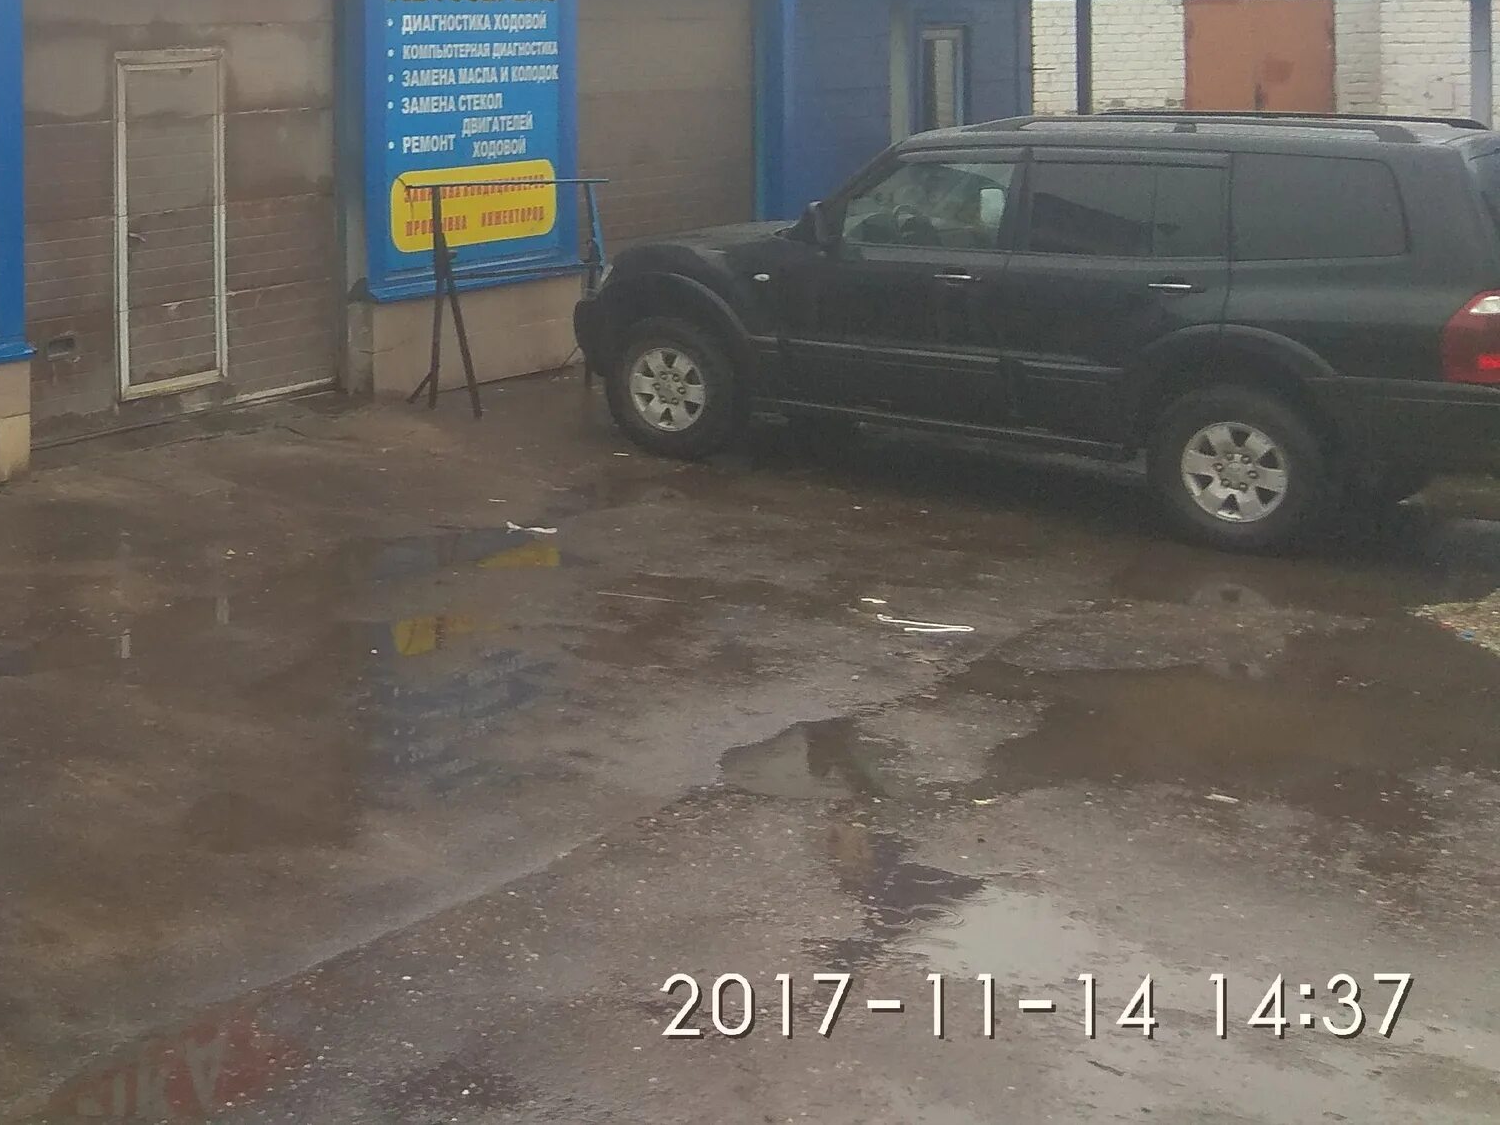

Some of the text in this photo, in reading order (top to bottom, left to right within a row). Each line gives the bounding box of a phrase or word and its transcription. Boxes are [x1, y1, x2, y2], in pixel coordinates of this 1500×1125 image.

[402, 10, 547, 35] ДИАГНОСТИКА ХОДОВОЙ
[402, 41, 559, 59] КОМПЬЮТЕРНАЯ ДИАГНОСТИКА
[402, 64, 559, 87] ЗАМЕНА МАСЛА И КОЛОДОК
[401, 92, 503, 114] ЗАМЕНА СТЕКОЛ
[461, 110, 533, 138] ДВИГАТЕЛЕЙ
[402, 134, 457, 154] РЕМОНТ
[472, 135, 527, 159] ХОДОВОЙ
